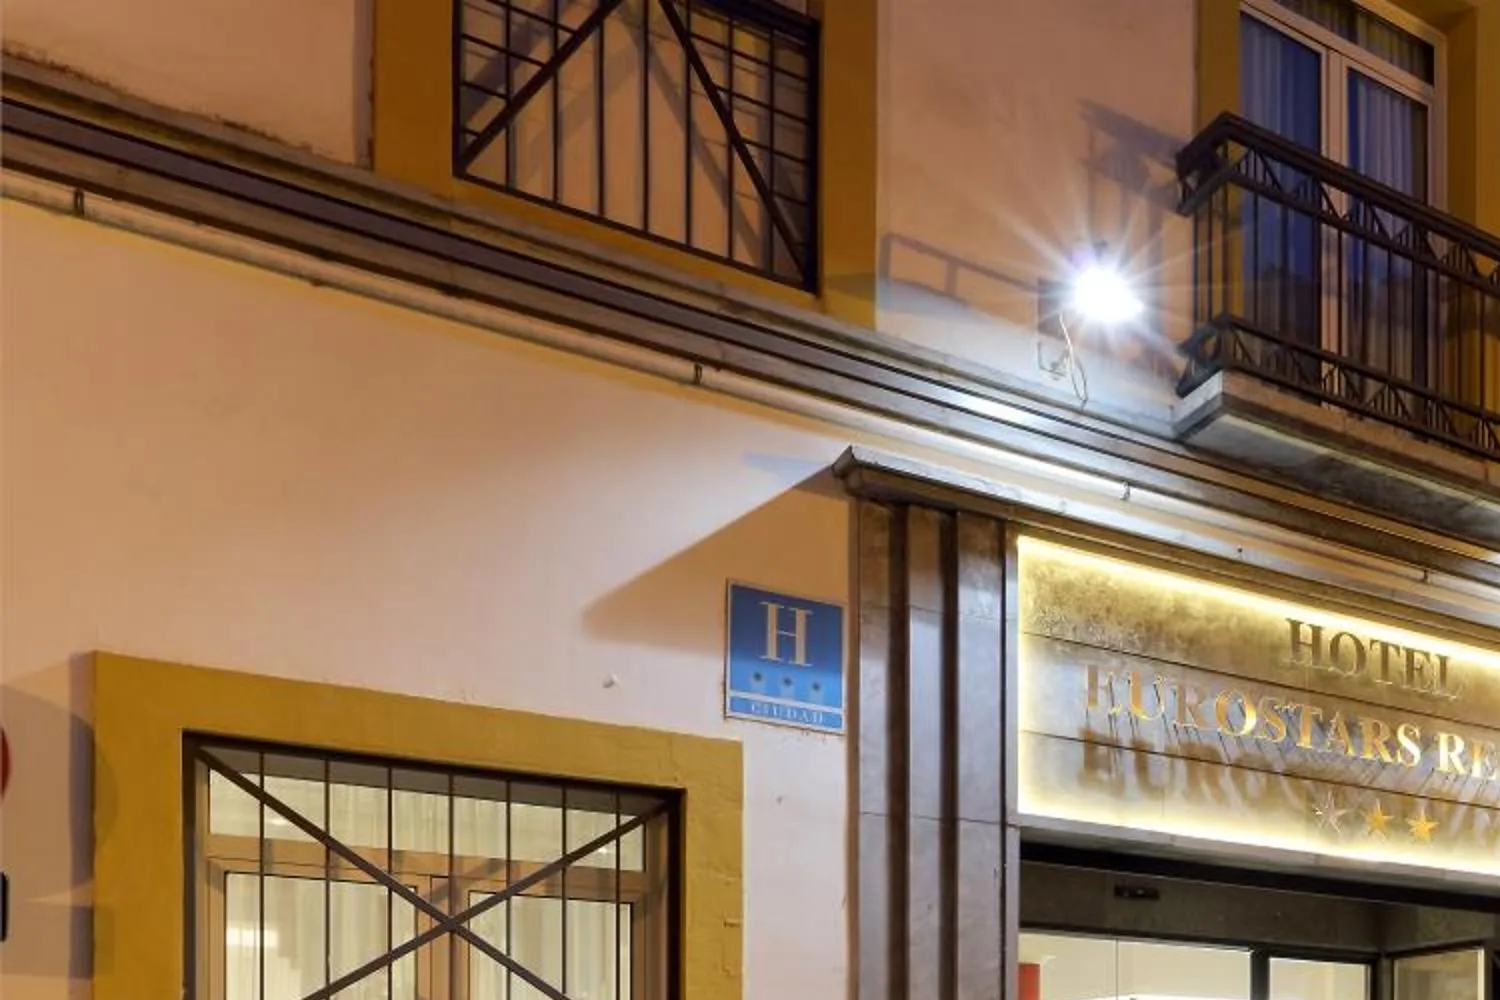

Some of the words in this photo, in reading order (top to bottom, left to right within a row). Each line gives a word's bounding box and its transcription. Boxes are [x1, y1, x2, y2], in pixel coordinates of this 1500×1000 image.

[759, 601, 813, 667] H
[1283, 617, 1464, 699] HOTEL
[1081, 662, 1421, 768] EUROSTARS
